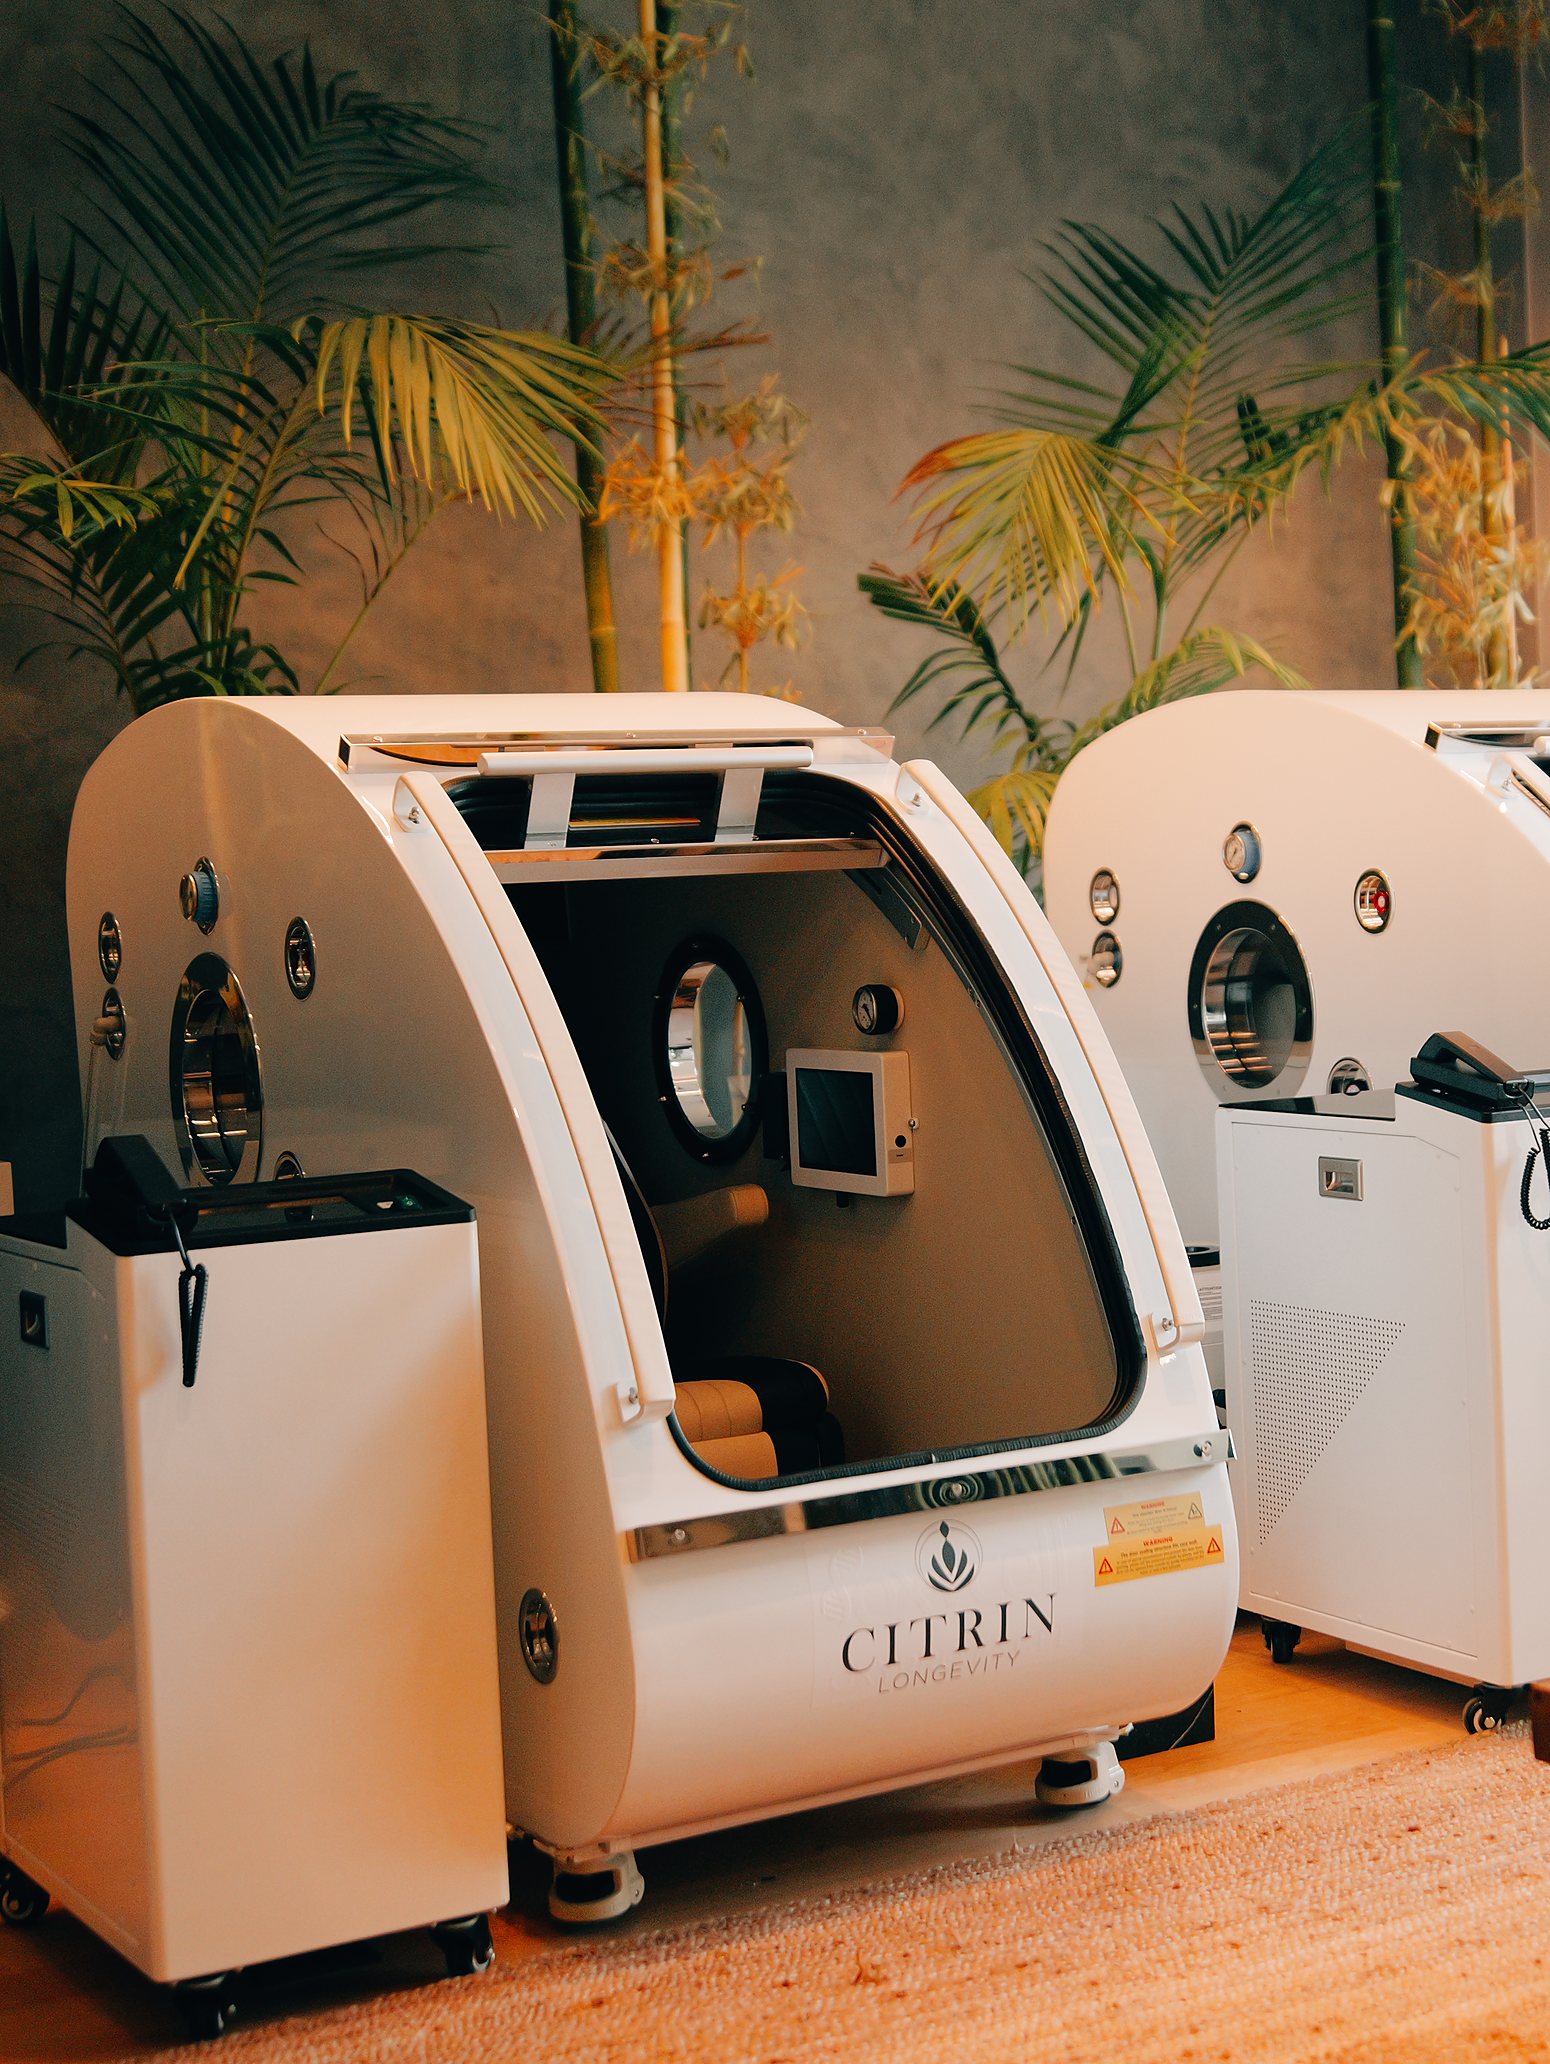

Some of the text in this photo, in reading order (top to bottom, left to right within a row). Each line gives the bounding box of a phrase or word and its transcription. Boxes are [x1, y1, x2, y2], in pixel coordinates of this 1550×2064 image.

[1143, 1536, 1173, 1547] WARNING
[842, 1592, 1056, 1672] CITRIN
[878, 1650, 1021, 1694] LONGEVITY
